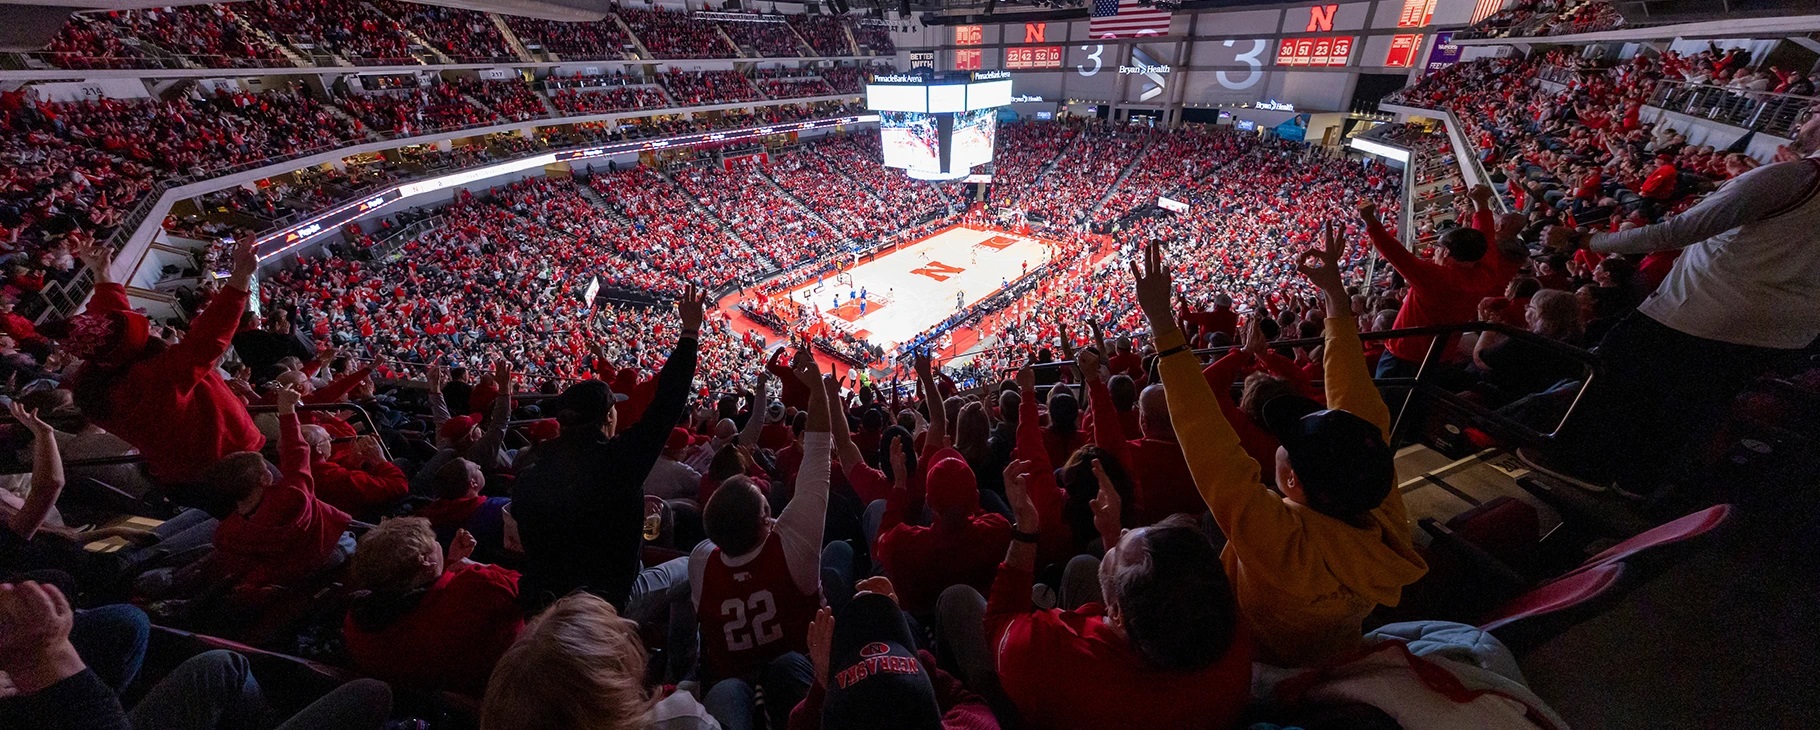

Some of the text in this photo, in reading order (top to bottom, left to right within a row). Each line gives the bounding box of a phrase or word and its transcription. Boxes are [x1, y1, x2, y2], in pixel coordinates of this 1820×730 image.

[1306, 4, 1338, 32] N
[1025, 22, 1046, 42] N
[1281, 46, 1293, 56] 30
[1298, 46, 1309, 56] 51
[1315, 46, 1329, 56] 23
[1333, 45, 1348, 55] 35
[1007, 53, 1019, 61] 22
[1021, 53, 1032, 61] 42
[1035, 52, 1046, 60] 52
[1050, 52, 1059, 60] 10
[912, 60, 933, 69] WITH
[1119, 65, 1170, 75] Bryan Health
[1256, 101, 1295, 112] Bryan Health
[720, 589, 784, 651] 22
[835, 655, 919, 690] NEBRASKA
